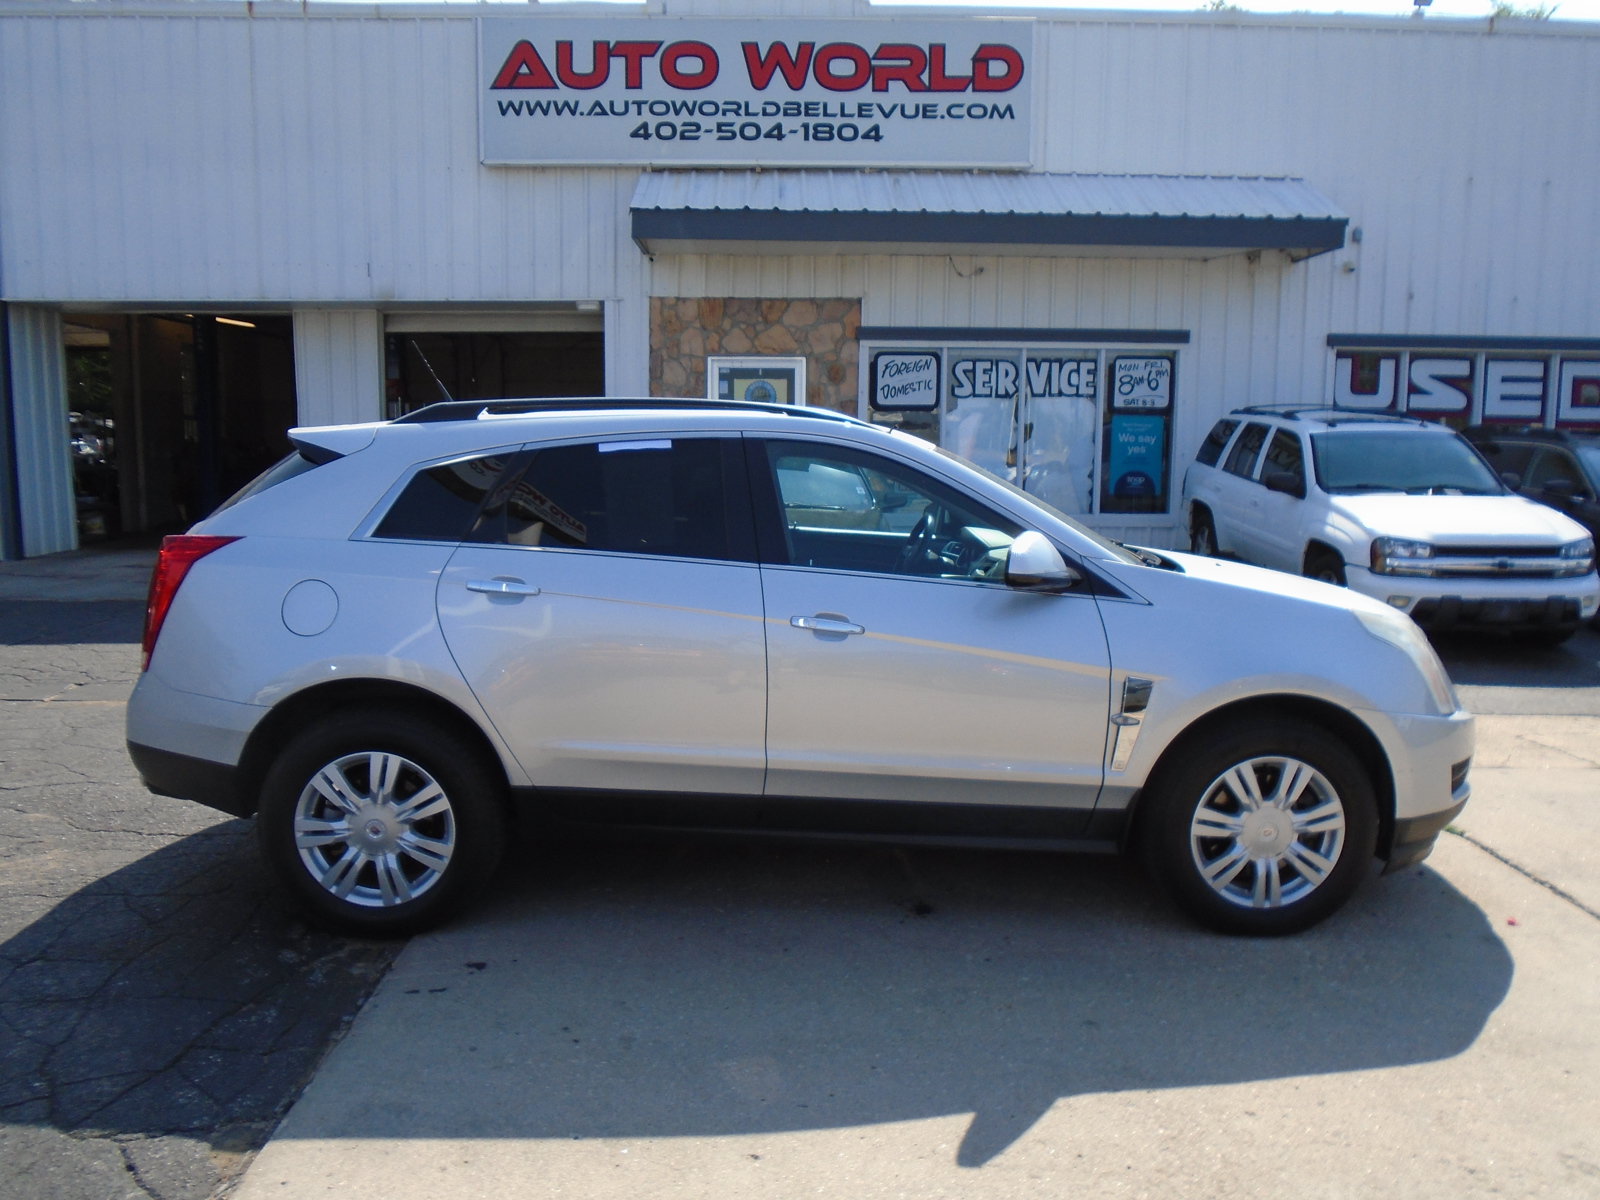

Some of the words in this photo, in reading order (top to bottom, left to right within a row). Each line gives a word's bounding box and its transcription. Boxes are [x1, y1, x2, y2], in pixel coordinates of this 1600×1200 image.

[489, 39, 720, 90] AUTO
[741, 40, 1024, 92] WORLD
[497, 100, 1015, 119] WWW.AUTOWORLDBELLEVUE.COM
[629, 121, 883, 142] 402-504-1804
[881, 357, 933, 379] FOREIGN
[952, 359, 1097, 398] SERVICE
[880, 379, 933, 400] DOMESTIC
[1118, 432, 1136, 443] We
[1138, 435, 1157, 445] say
[1127, 445, 1147, 456] yes
